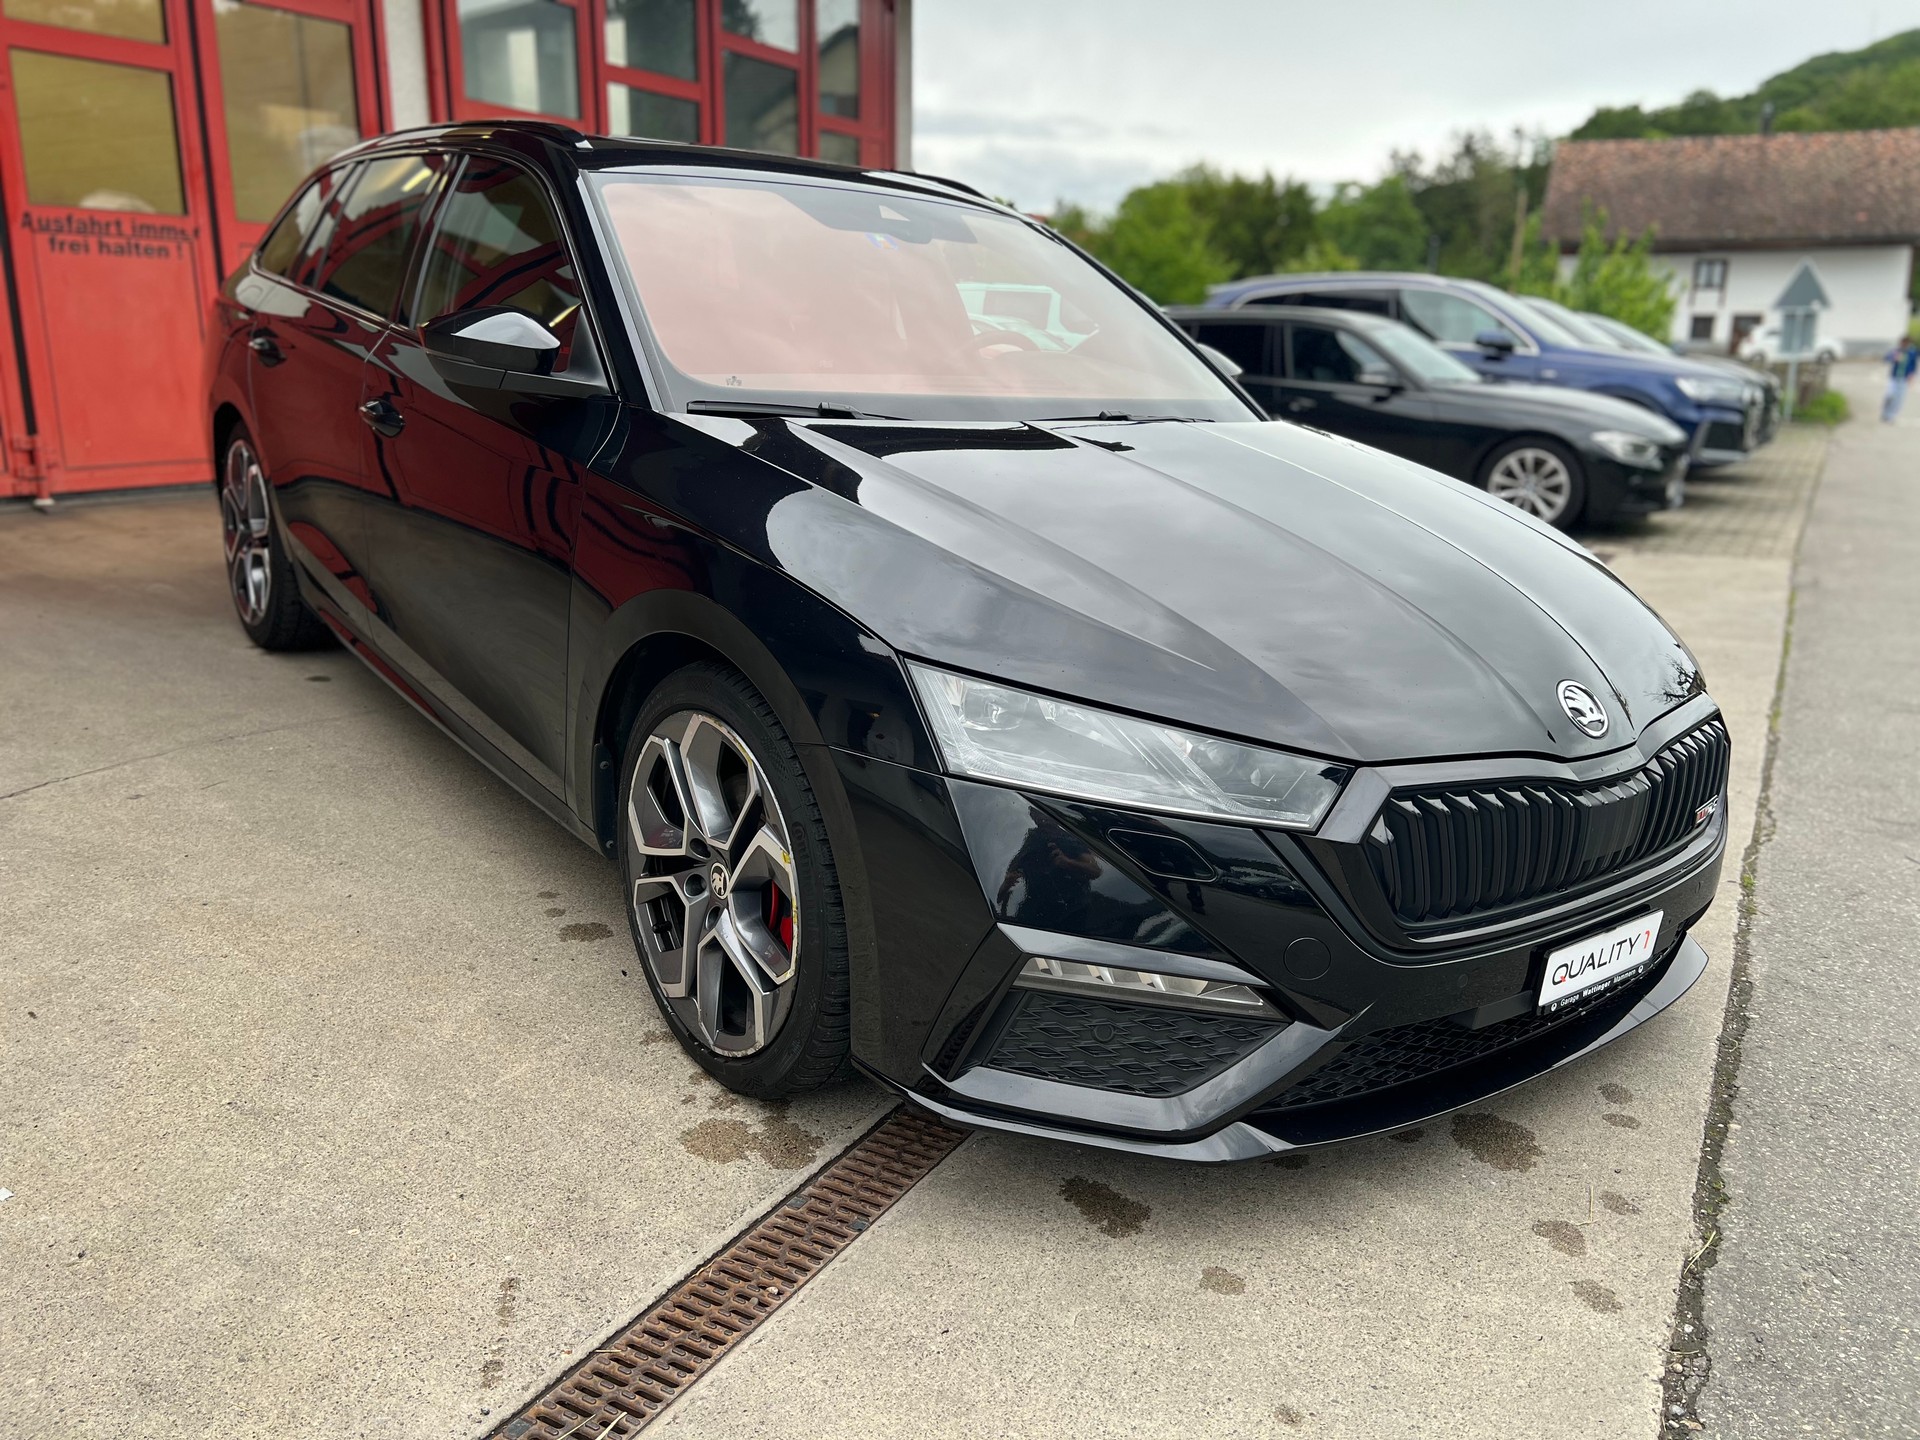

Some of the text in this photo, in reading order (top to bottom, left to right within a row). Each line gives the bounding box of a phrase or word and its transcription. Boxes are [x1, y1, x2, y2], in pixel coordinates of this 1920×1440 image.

[20, 211, 125, 237] Ausfahrt
[48, 236, 91, 254] frei
[98, 239, 171, 258] halten
[1552, 933, 1641, 986] QUALITY
[1560, 994, 1580, 1006] Garage
